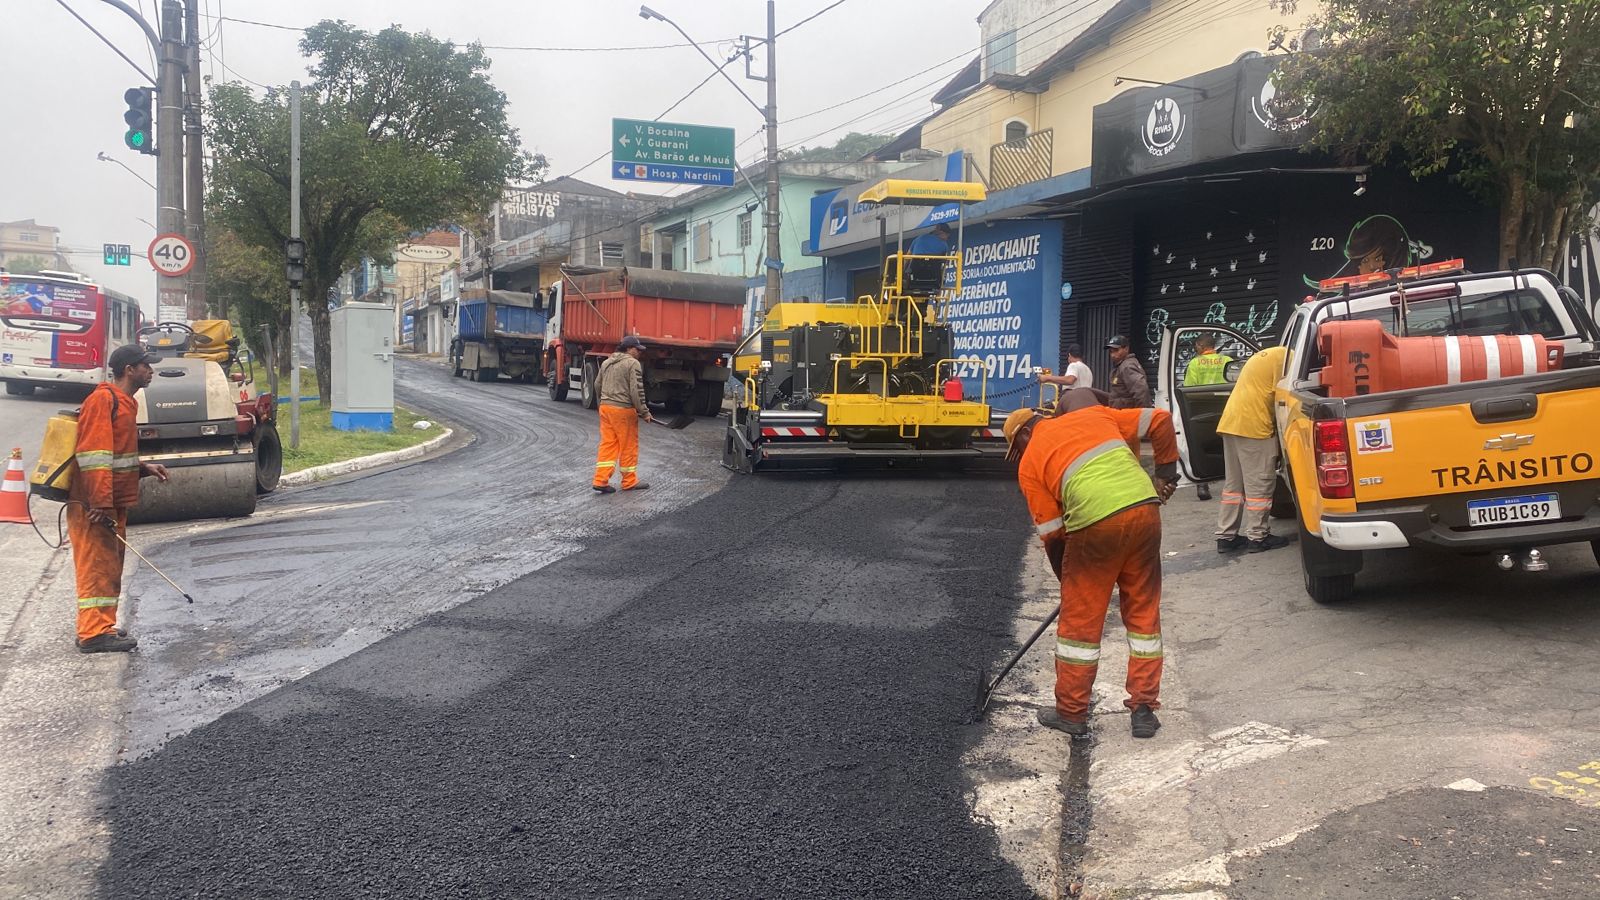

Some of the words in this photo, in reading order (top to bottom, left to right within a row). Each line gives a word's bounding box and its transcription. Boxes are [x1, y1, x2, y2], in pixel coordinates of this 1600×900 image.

[635, 125, 644, 134] V.
[647, 126, 690, 138] Bocaina
[1154, 123, 1172, 135] RIVAS
[635, 137, 644, 146] V.
[647, 138, 689, 150] Guarani
[1148, 145, 1164, 157] ROCK
[1164, 142, 1177, 155] BAR
[635, 150, 650, 159] Av.
[654, 151, 685, 162] Barão
[688, 154, 700, 163] de
[703, 155, 730, 165] Mauá
[652, 169, 680, 180] Hosp.
[684, 171, 721, 182] Nardini
[930, 208, 959, 222] 2629-9174
[964, 234, 1041, 266] DESPACHANTE
[1310, 237, 1335, 251] 120
[155, 243, 187, 261] 40
[945, 266, 981, 283] ASSSSORIA
[984, 257, 1036, 277] DOCUMENTAÇÃO
[984, 335, 996, 349] DE
[997, 334, 1020, 349] CNH
[1431, 452, 1593, 488] TRÂNSITO
[1478, 502, 1550, 524] RUB1C89
